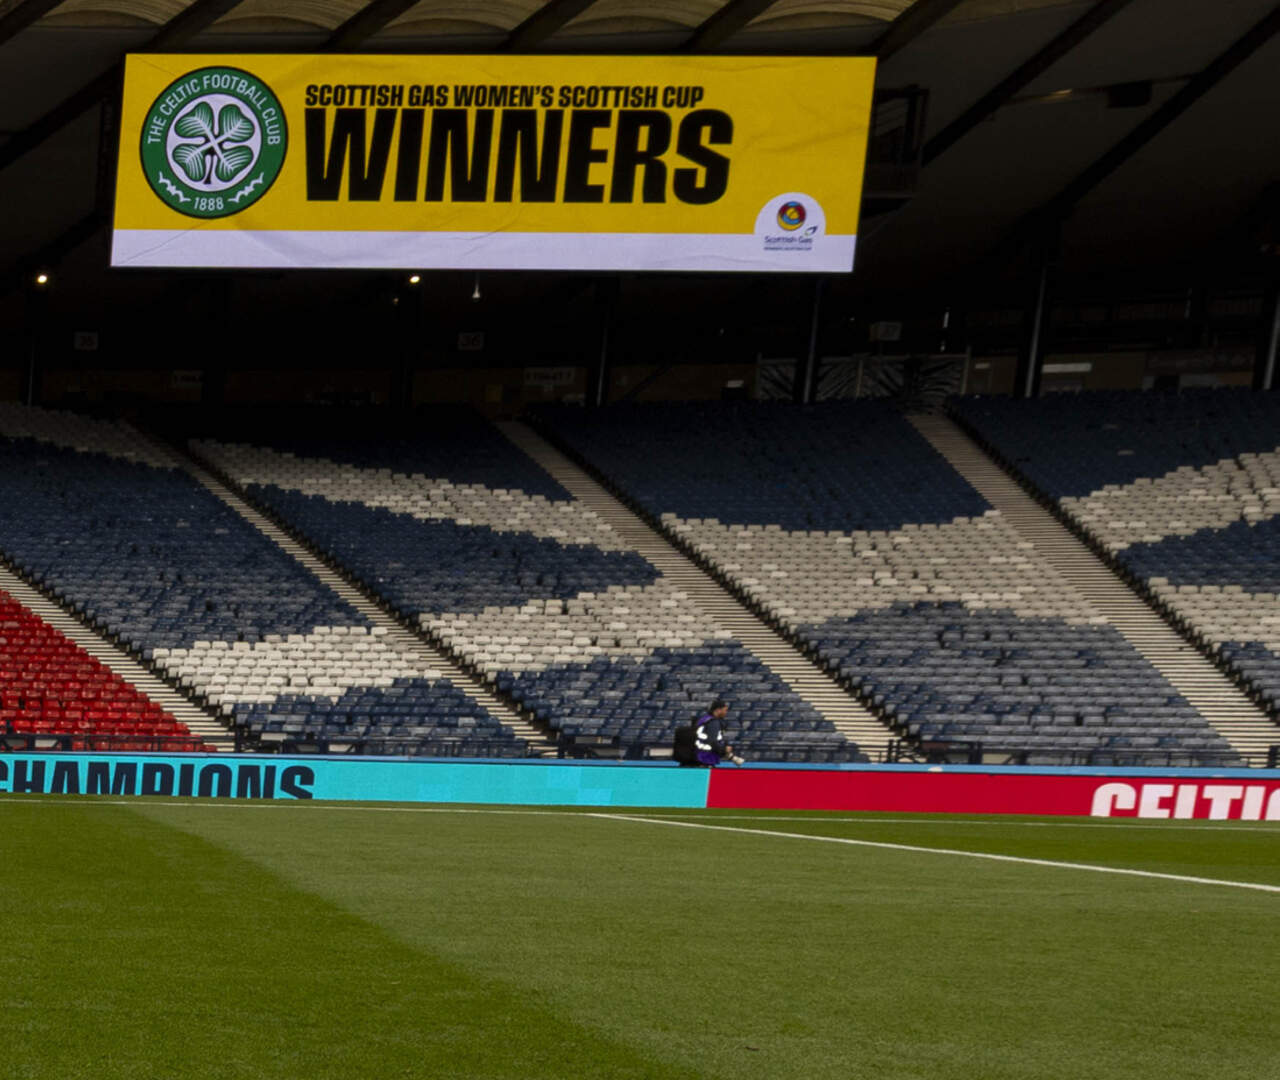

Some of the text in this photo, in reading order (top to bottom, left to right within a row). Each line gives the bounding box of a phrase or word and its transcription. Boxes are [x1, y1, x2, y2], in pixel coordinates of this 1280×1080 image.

[147, 74, 281, 145] THE CELTIC FOOTBALL CLUB
[305, 84, 705, 108] SCOTTISH GAS WOMEN'S SCOTTISH CUP
[304, 107, 734, 205] WINNERS
[193, 197, 224, 211] 1888
[1090, 782, 1280, 821] CELTI
